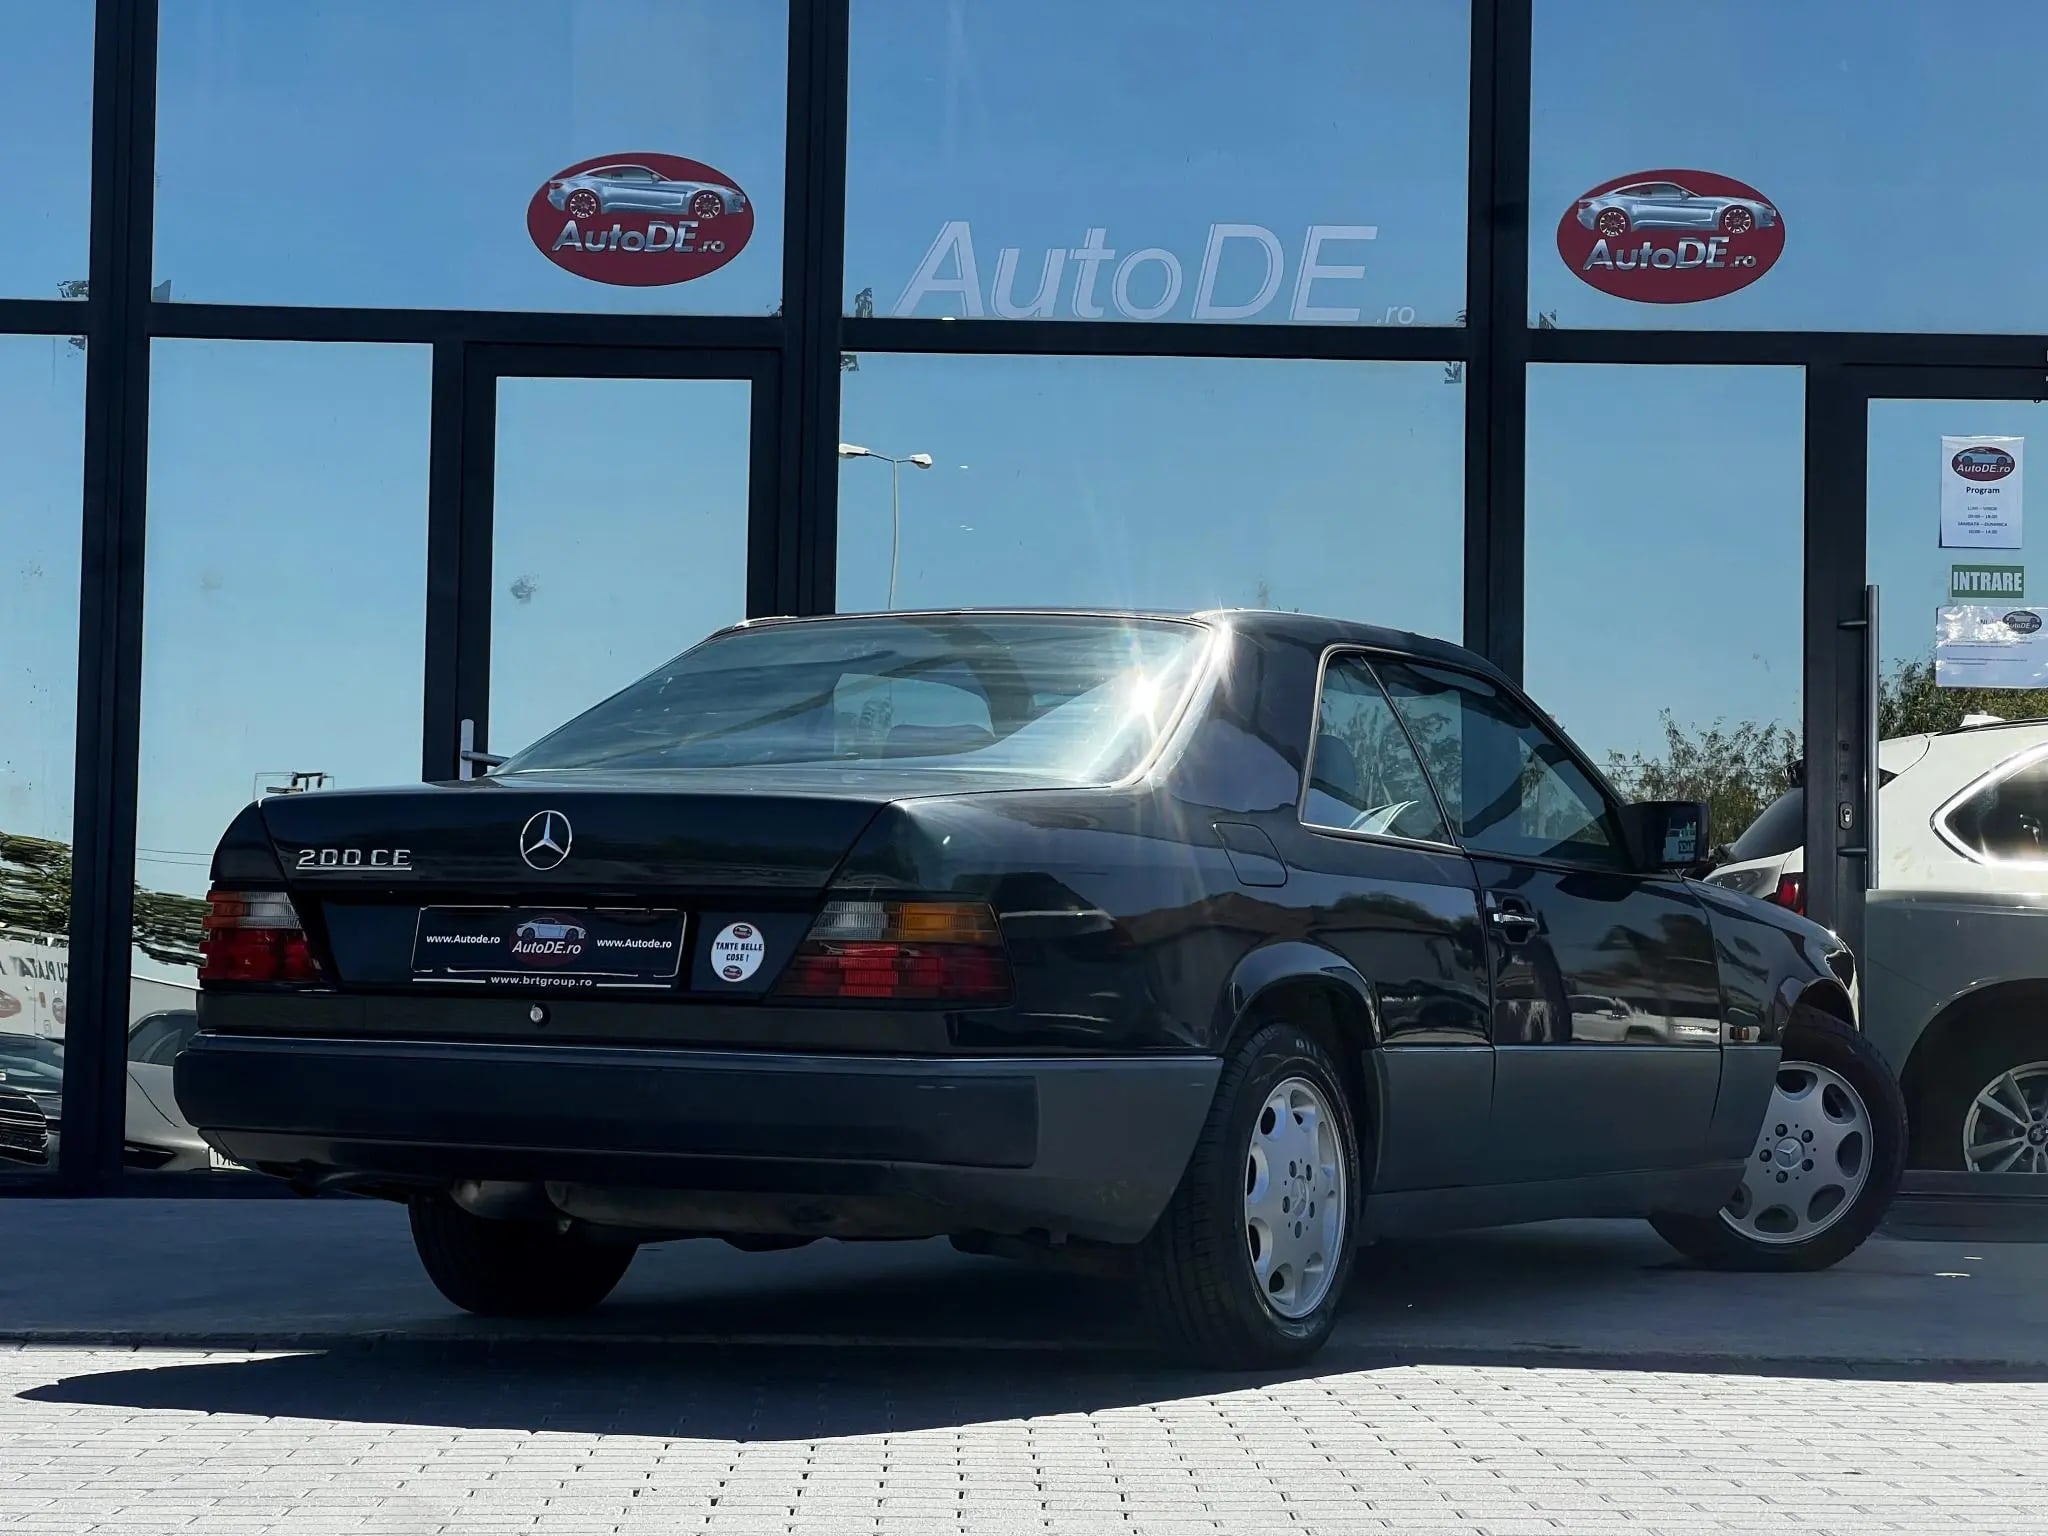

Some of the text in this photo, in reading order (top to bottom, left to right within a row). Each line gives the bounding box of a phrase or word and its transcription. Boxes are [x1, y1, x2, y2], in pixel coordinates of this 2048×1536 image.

[1966, 486, 2000, 496] Program
[1953, 571, 2022, 591] INTRARE
[298, 849, 411, 866] 200 CE
[426, 934, 501, 945] www.Autode.ro
[596, 938, 673, 949] www.Autode.ro
[512, 940, 582, 955] AutoDE.ro
[716, 942, 763, 952] TANTE BELLE
[726, 953, 744, 961] COSE
[490, 976, 593, 988] www.brtgroup.ro
